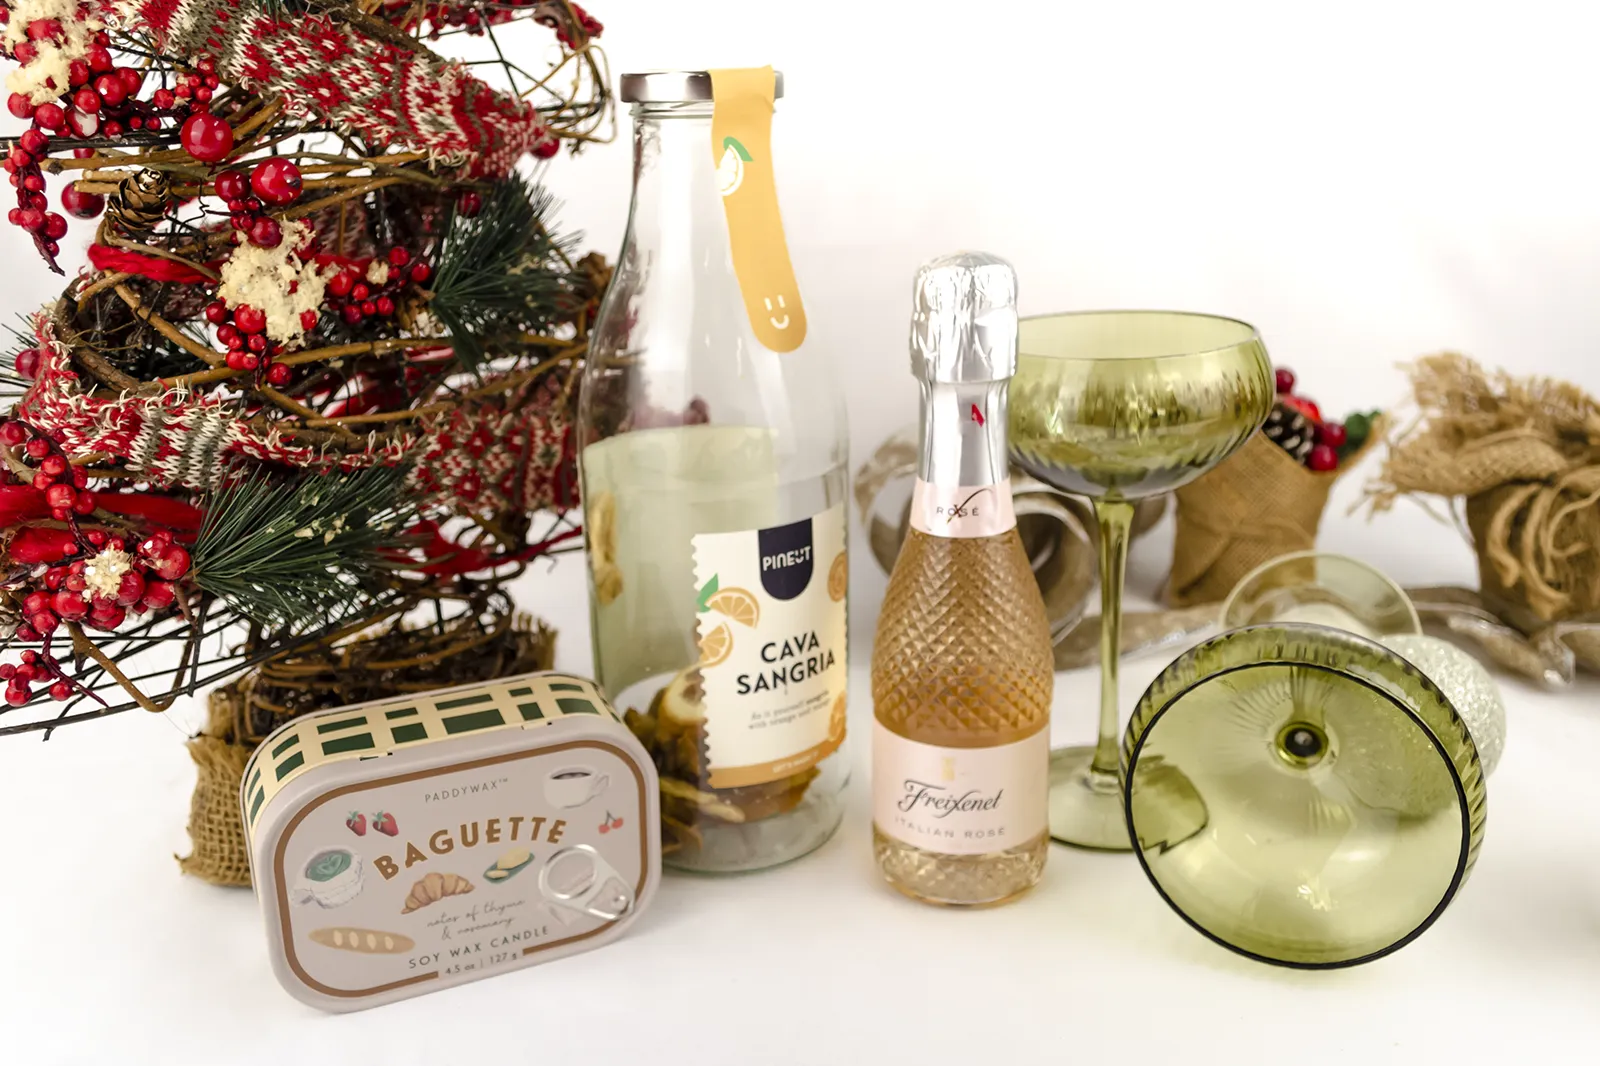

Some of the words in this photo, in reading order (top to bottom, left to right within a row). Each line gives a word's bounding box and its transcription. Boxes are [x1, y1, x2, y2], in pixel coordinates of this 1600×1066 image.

[760, 630, 820, 663] CAVA
[736, 649, 836, 695] SANGRIA
[894, 815, 955, 839] ITALIAN
[373, 816, 567, 881] BAGUETTE
[465, 905, 480, 921] of
[408, 953, 440, 969] SOY
[450, 943, 482, 958] WAX
[490, 925, 549, 948] CANDLE
[490, 952, 508, 965] 127
